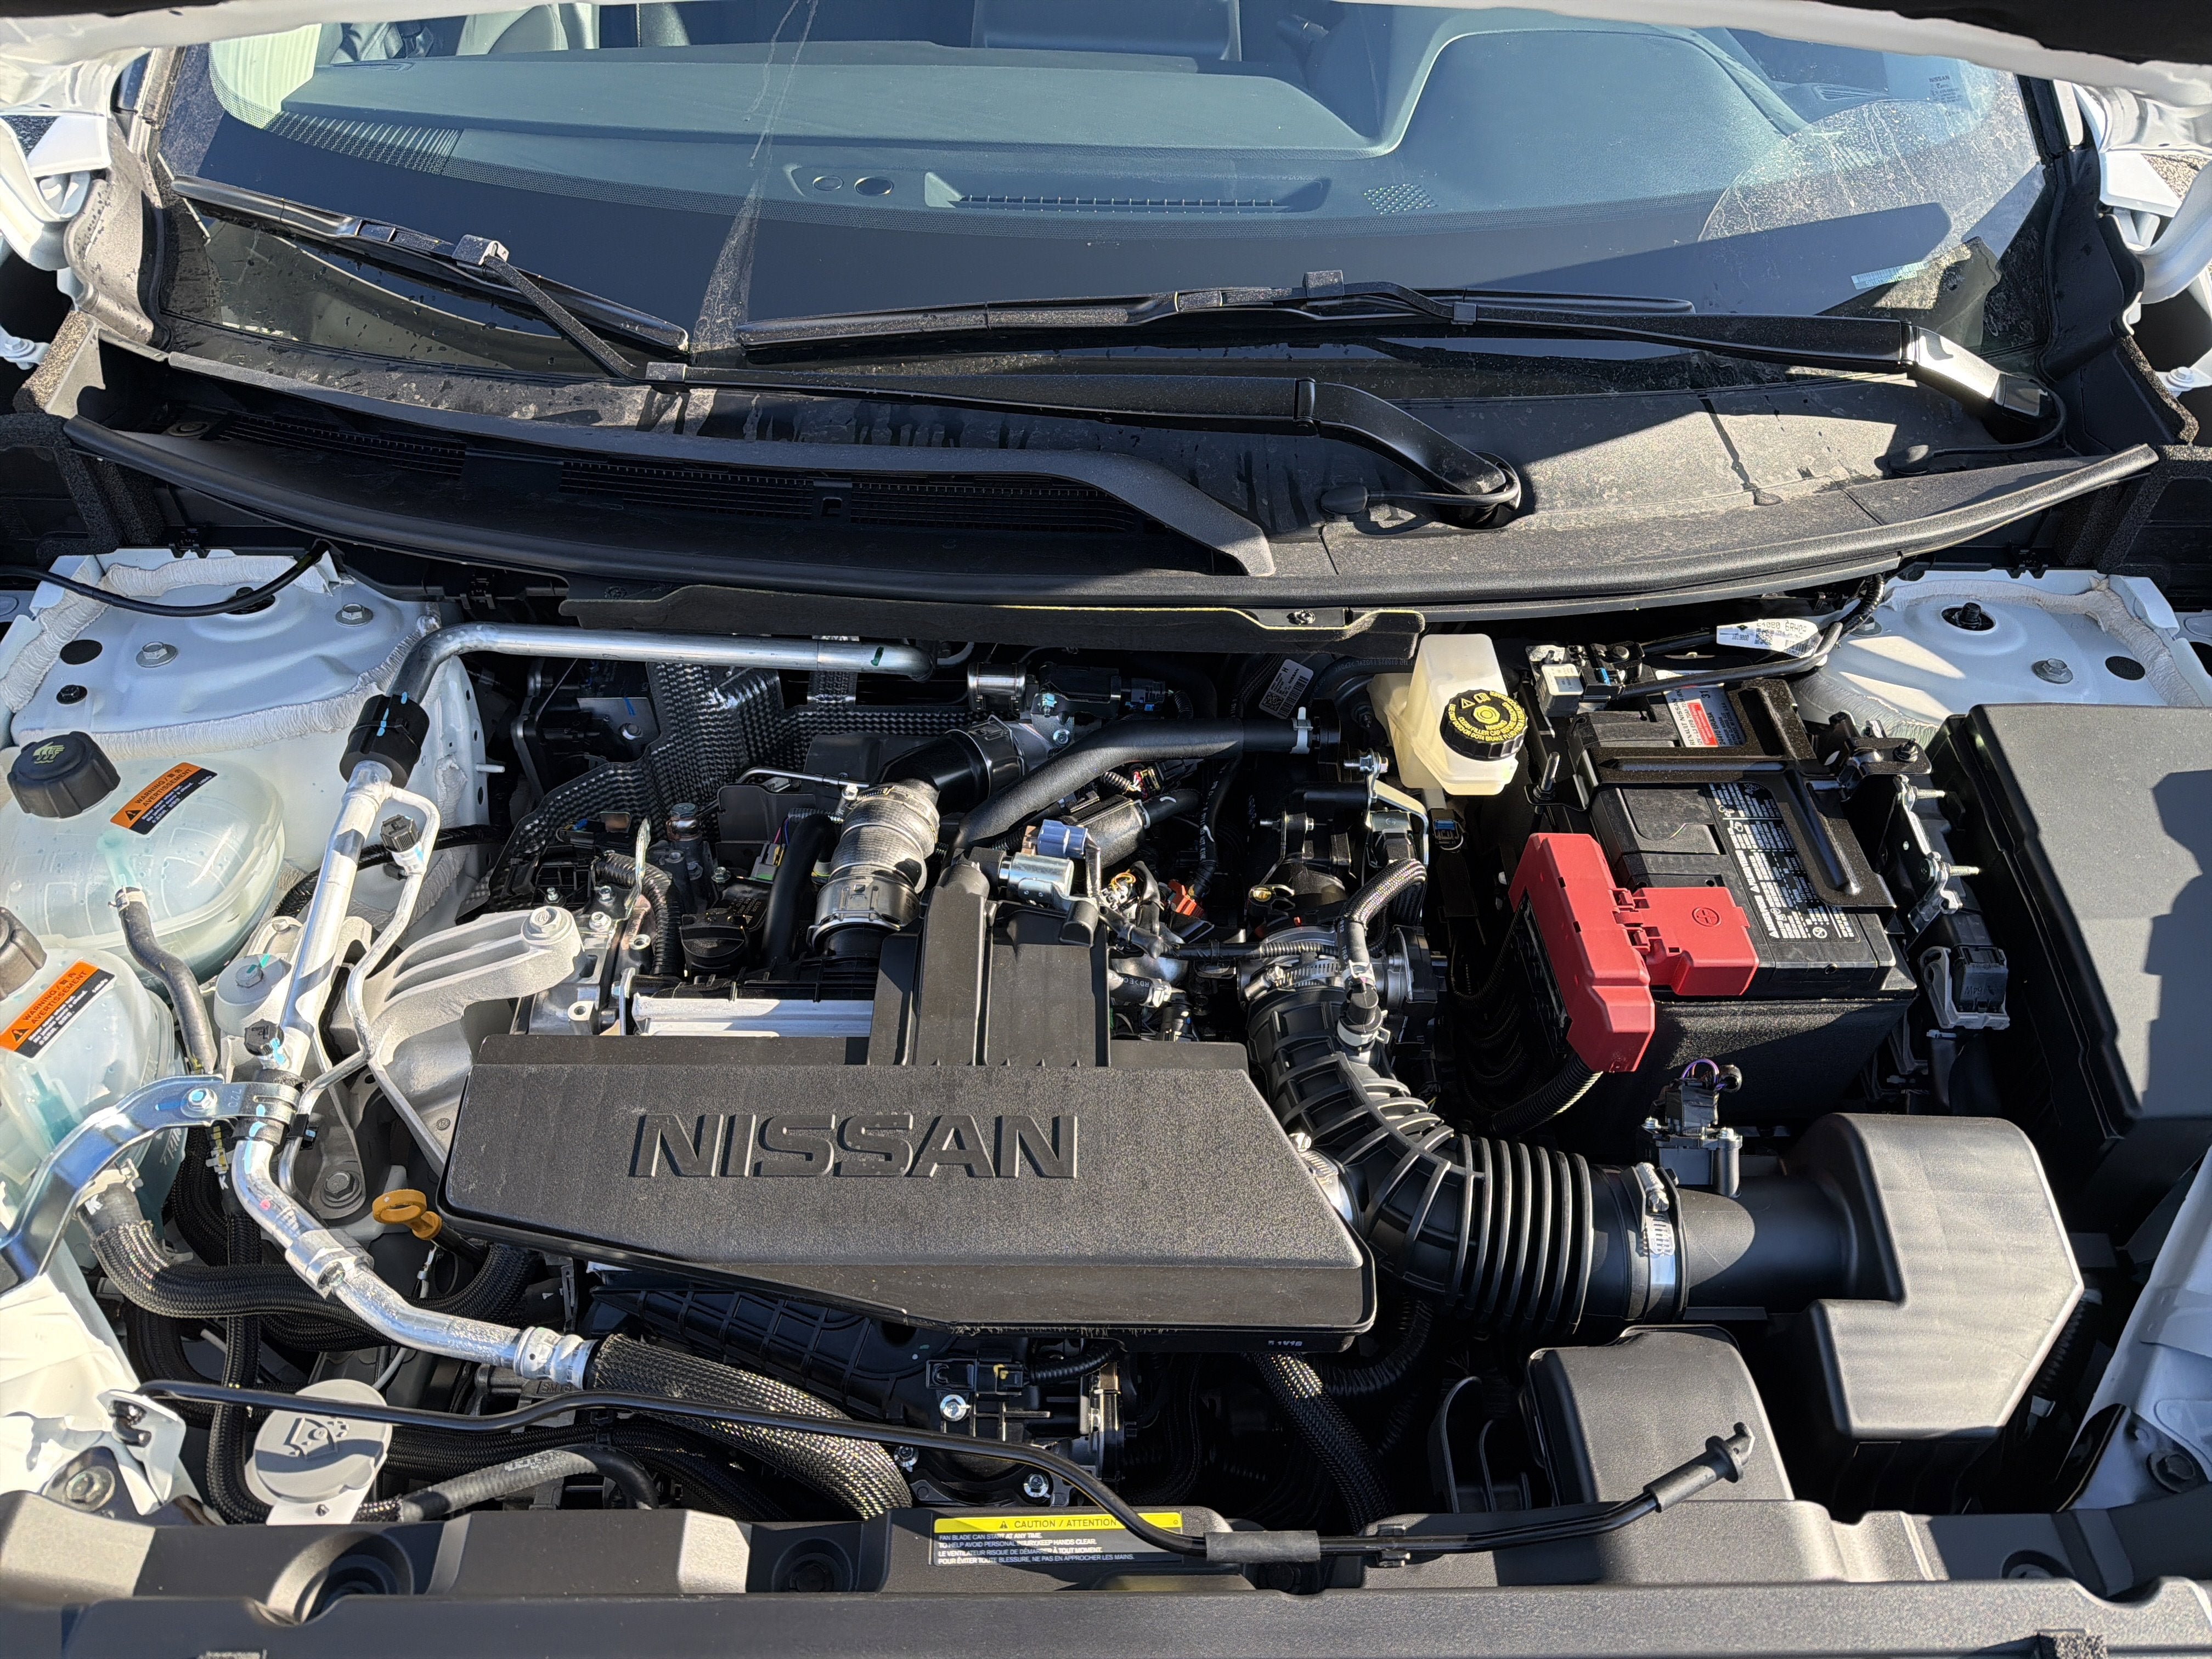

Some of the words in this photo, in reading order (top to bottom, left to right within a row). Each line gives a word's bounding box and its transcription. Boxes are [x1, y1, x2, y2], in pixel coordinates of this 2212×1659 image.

[1672, 698, 1685, 721] NISSAN
[1707, 712, 1719, 730] 6RA3A
[1458, 716, 1471, 729] CLEAN
[1471, 726, 1489, 736] FILLER
[1485, 720, 1508, 730] WARNING
[1681, 723, 1696, 746] RENAULT
[1715, 730, 1725, 745] 24410
[135, 780, 165, 804] WARNING
[143, 769, 193, 807] AVERTISSEMENT
[22, 989, 57, 1020] WARNING
[31, 970, 87, 1024] AVERTISSEMENT
[228, 1088, 242, 1108] 720
[629, 1113, 1077, 1178] NISSAN
[1014, 1520, 1056, 1528] CAUTION
[1066, 1519, 1117, 1527] ATTENTION
